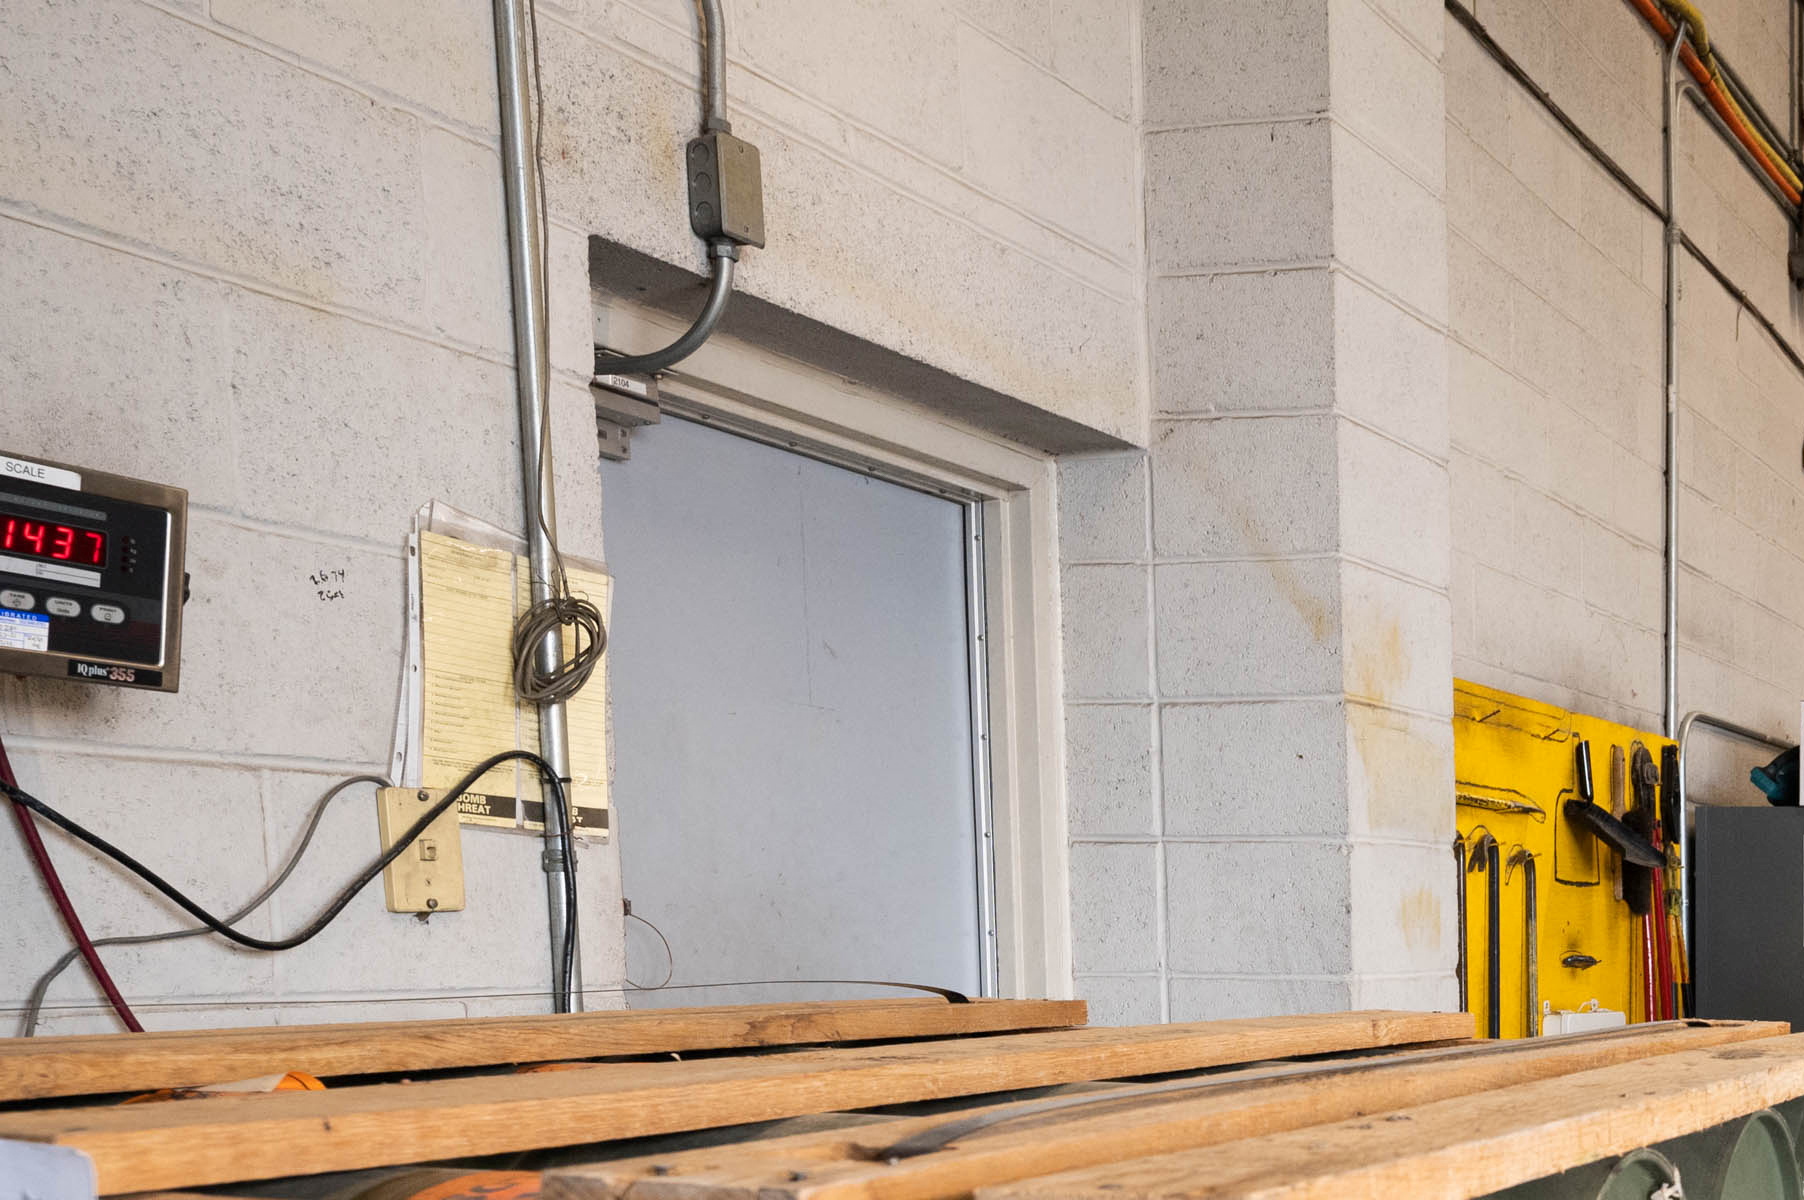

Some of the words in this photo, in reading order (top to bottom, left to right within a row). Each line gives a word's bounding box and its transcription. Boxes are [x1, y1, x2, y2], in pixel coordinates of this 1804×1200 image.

[5, 461, 45, 479] SCALE
[4, 520, 104, 564] 1437
[109, 666, 136, 682] 355
[457, 803, 492, 816] HREAT
